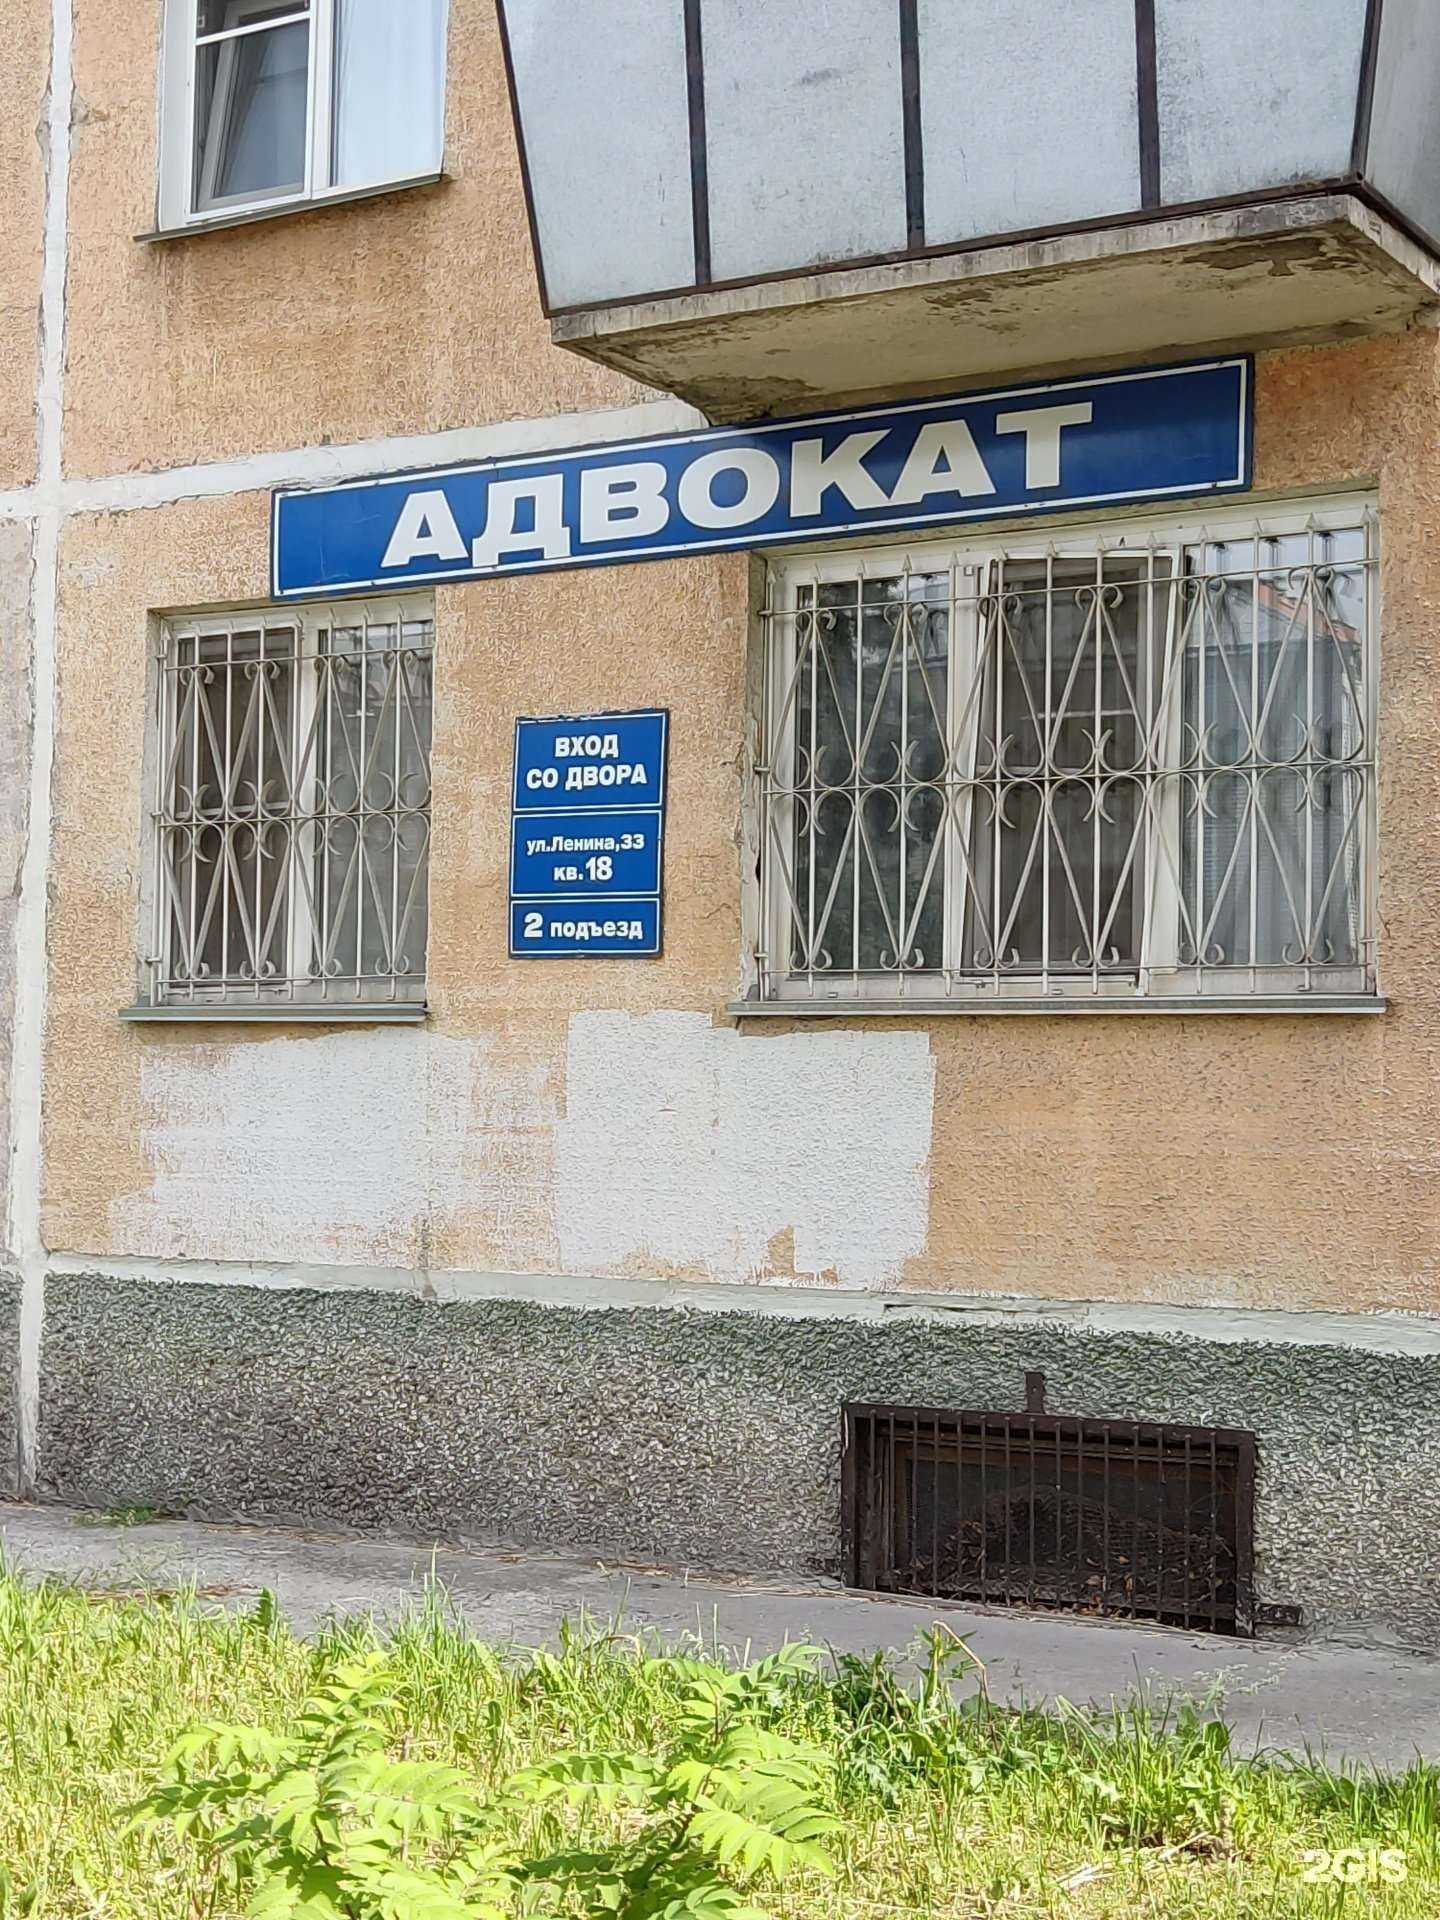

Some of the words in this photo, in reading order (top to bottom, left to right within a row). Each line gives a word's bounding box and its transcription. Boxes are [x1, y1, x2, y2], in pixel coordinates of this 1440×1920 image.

[381, 401, 1093, 569] АДВОКАТ
[554, 734, 619, 758] ВХОД
[526, 768, 559, 789] СО
[565, 764, 647, 790] ДВОРА
[523, 912, 543, 938] 2
[550, 920, 643, 940] подъезд
